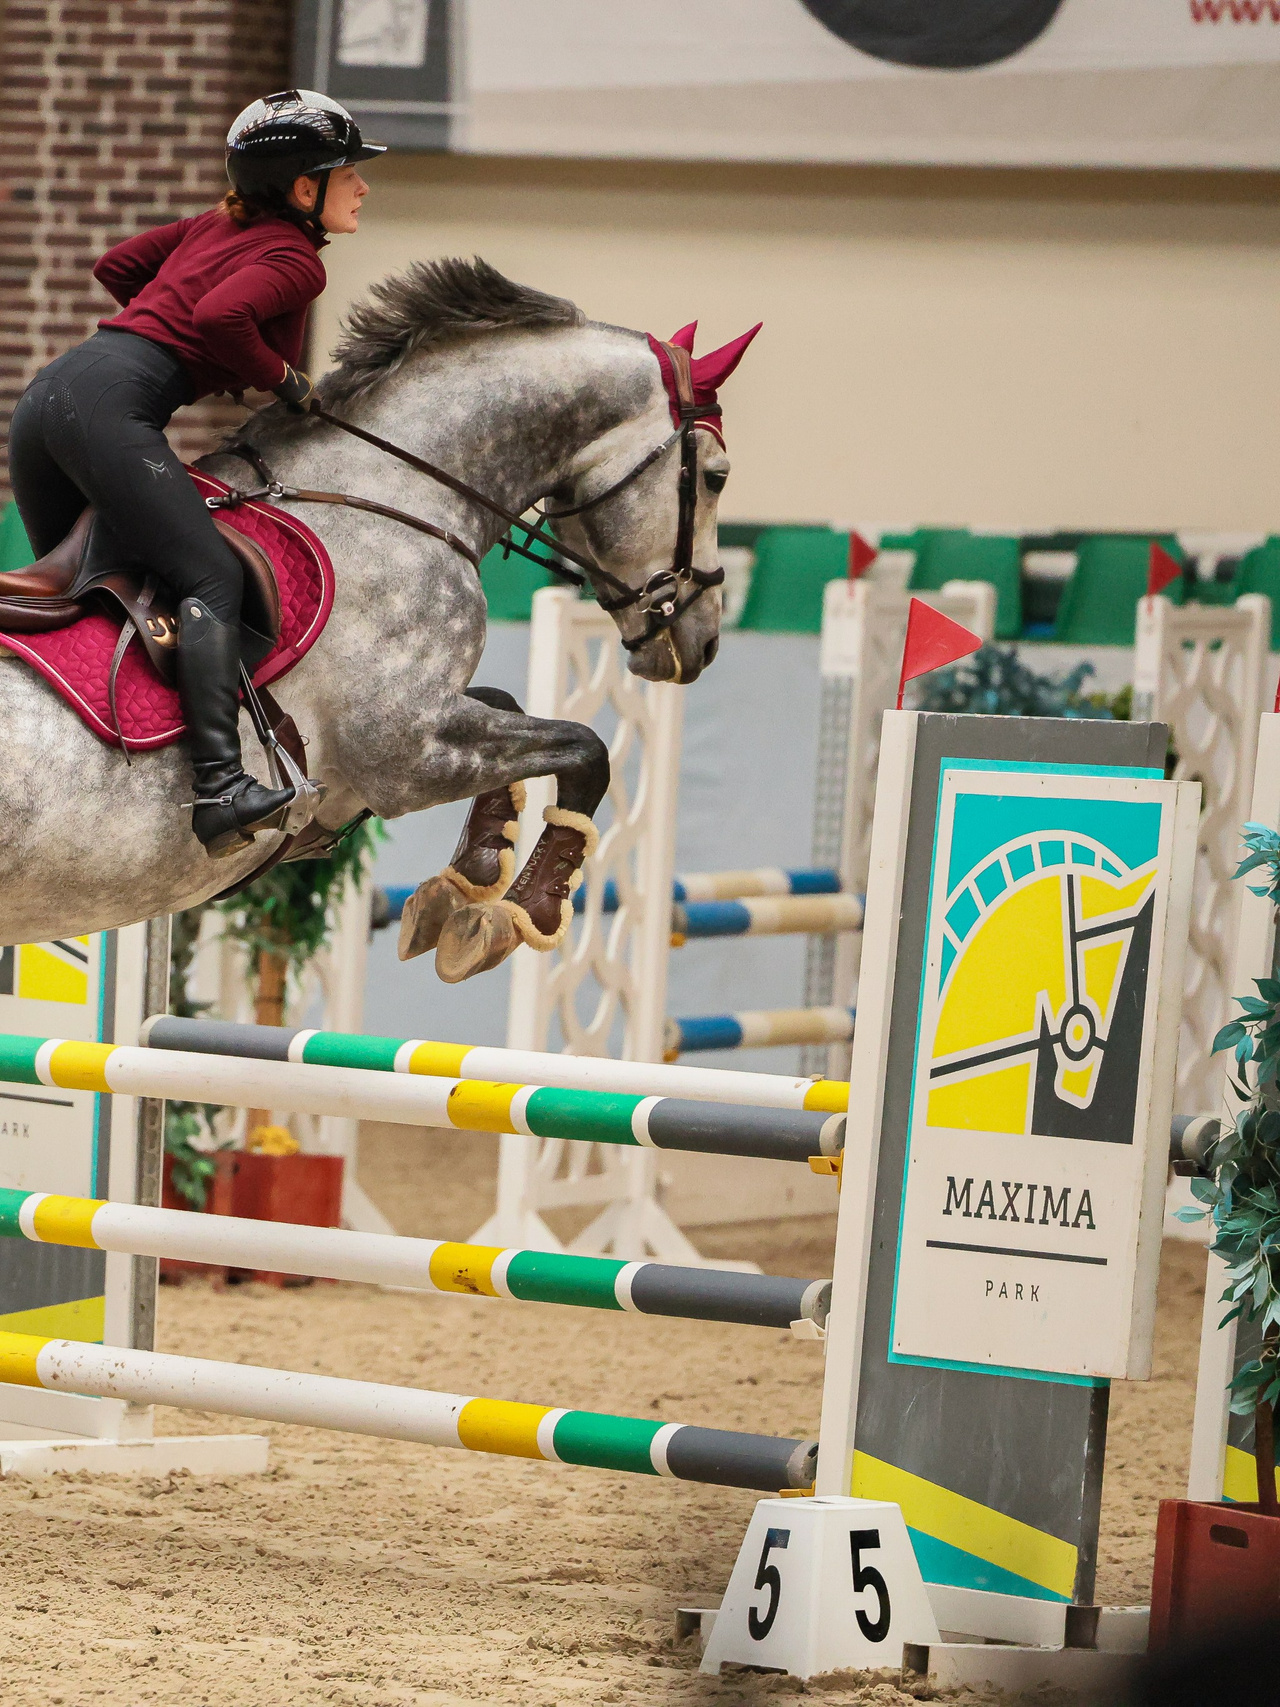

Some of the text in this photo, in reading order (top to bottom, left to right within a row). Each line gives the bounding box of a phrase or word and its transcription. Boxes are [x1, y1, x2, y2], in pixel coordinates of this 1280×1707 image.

[516, 838, 547, 891] KENTUCKY
[942, 1175, 1096, 1230] MAXIMA
[985, 1279, 1040, 1302] PARK
[748, 1527, 791, 1642] 5
[849, 1528, 892, 1643] 5
